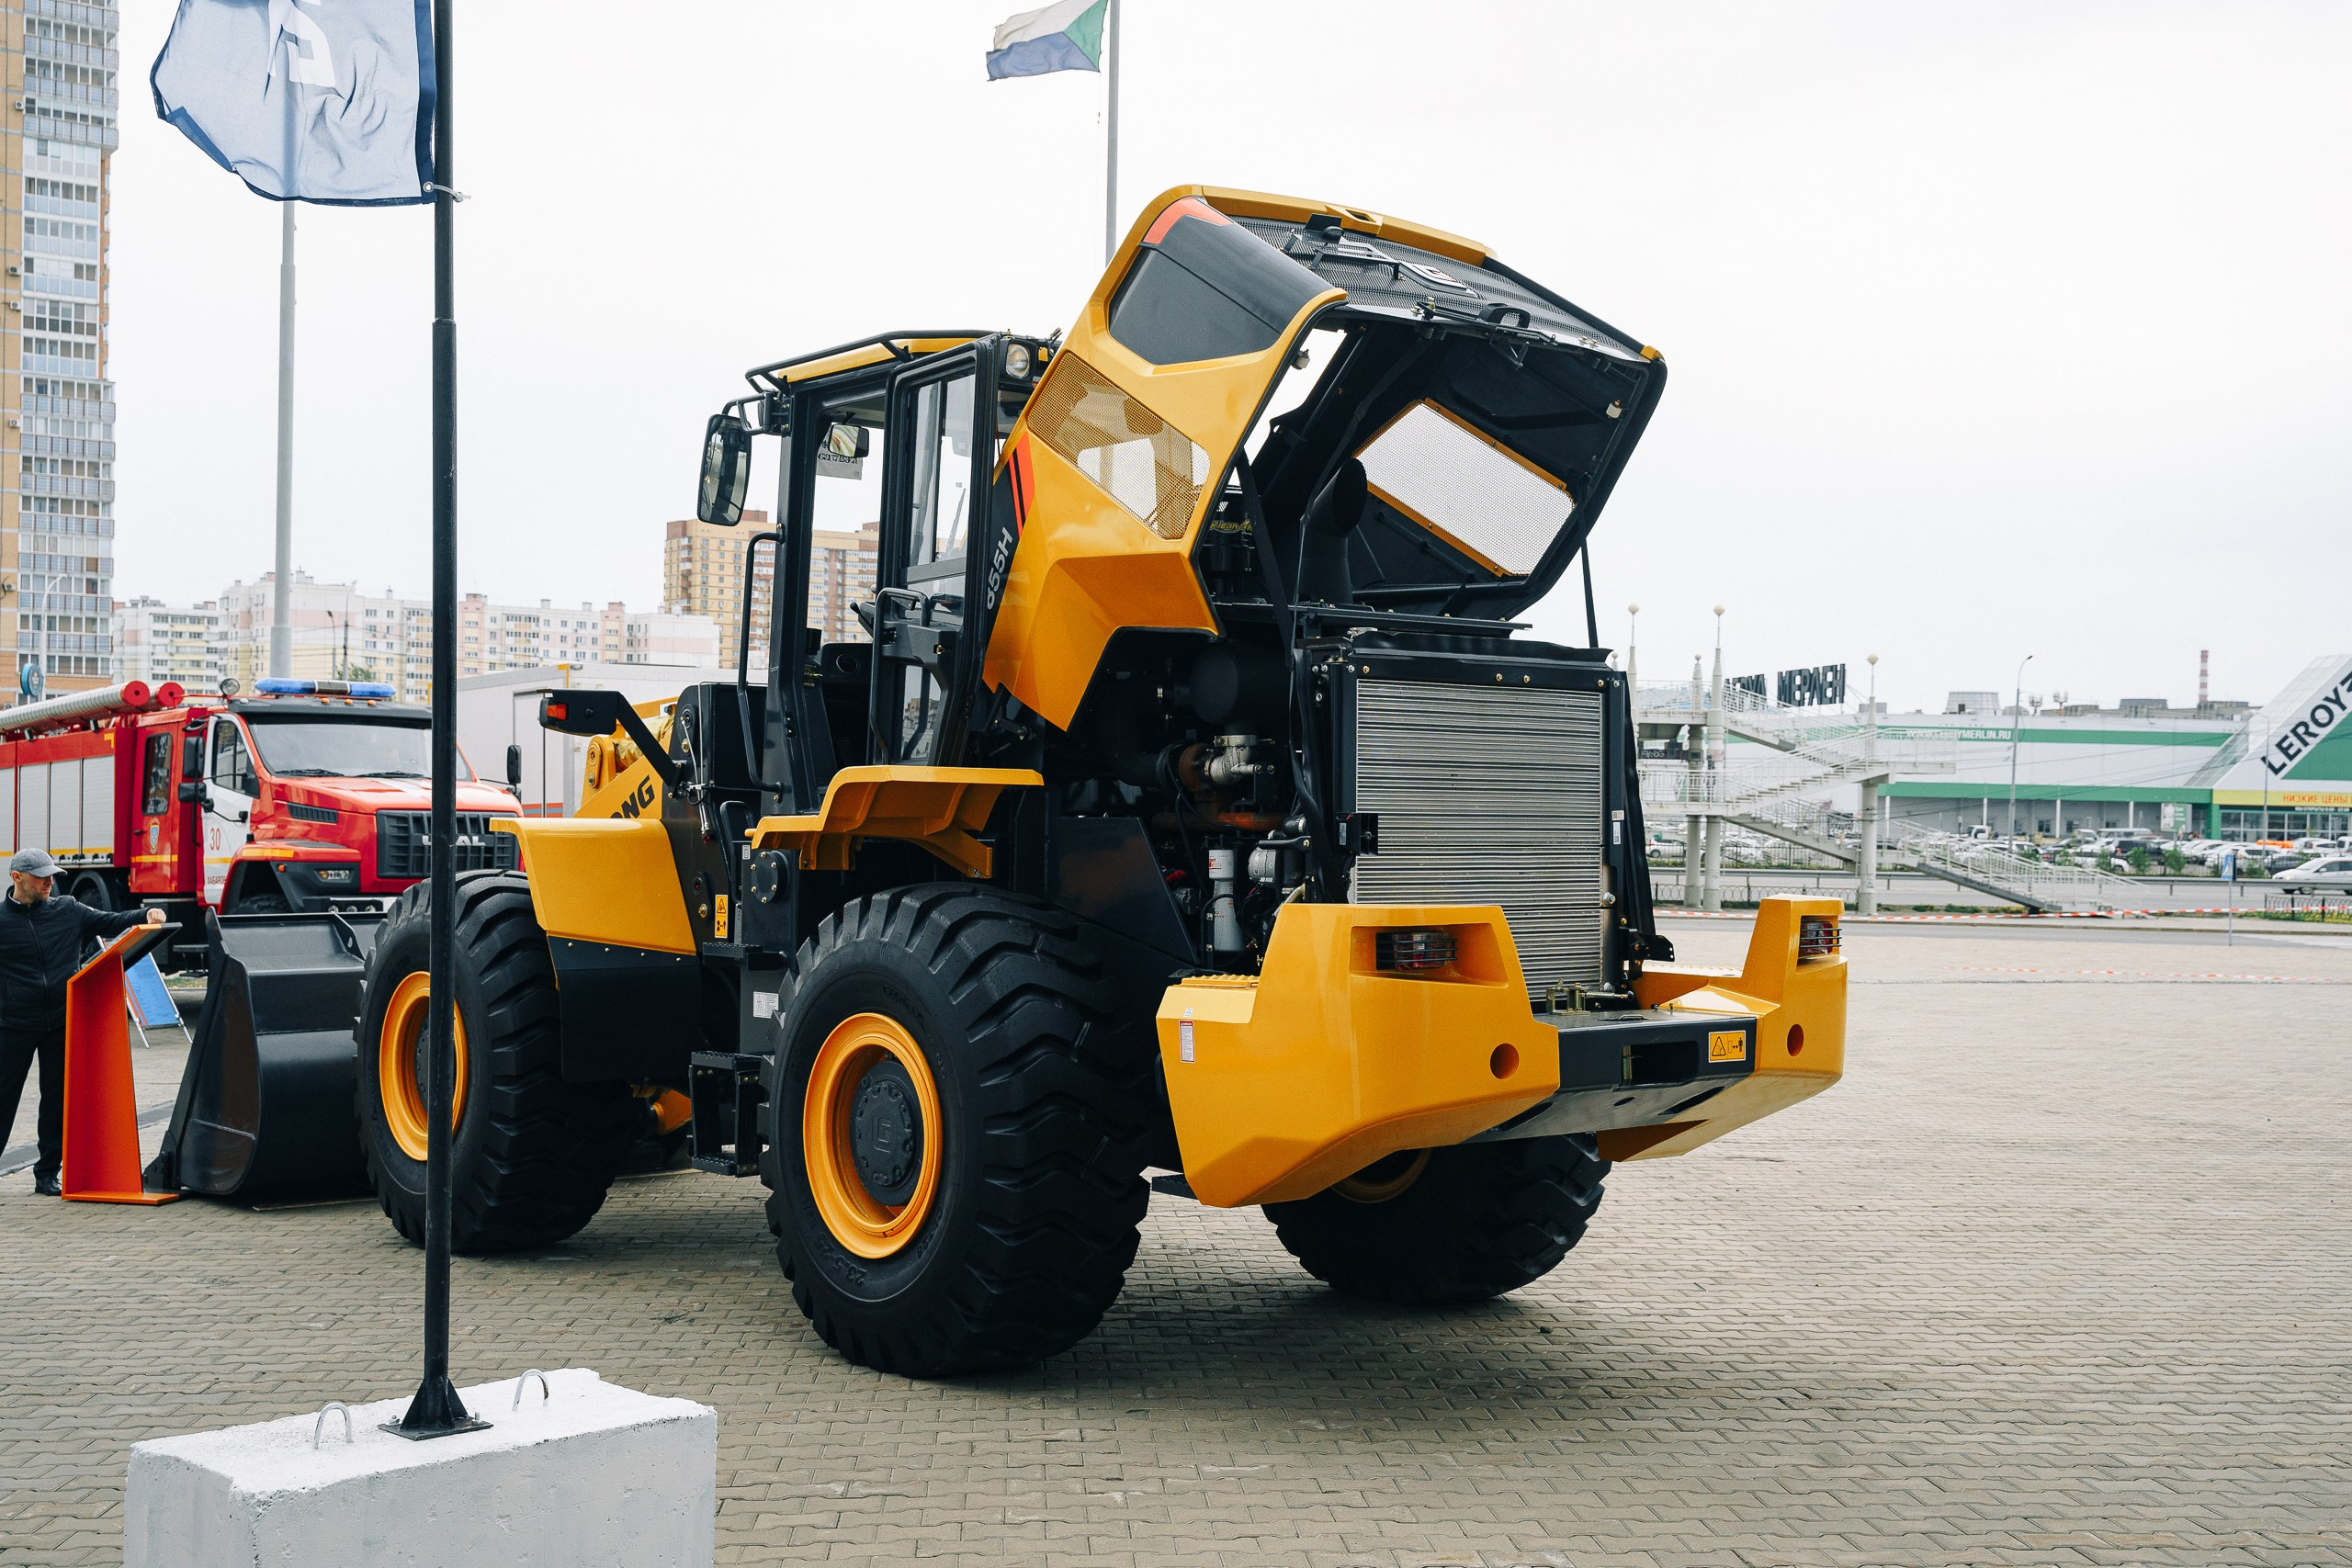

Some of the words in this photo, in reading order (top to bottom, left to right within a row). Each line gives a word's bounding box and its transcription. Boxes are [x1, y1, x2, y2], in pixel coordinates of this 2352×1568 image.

[987, 526, 1012, 610] 855H
[1777, 663, 1845, 707] МЕРЛЕН
[2261, 686, 2347, 775] LEROY
[2282, 794, 2318, 804] НИЗКИЕ
[2322, 795, 2348, 805] ЦЕНЫ
[209, 828, 221, 851] 30
[422, 835, 486, 846] UAL
